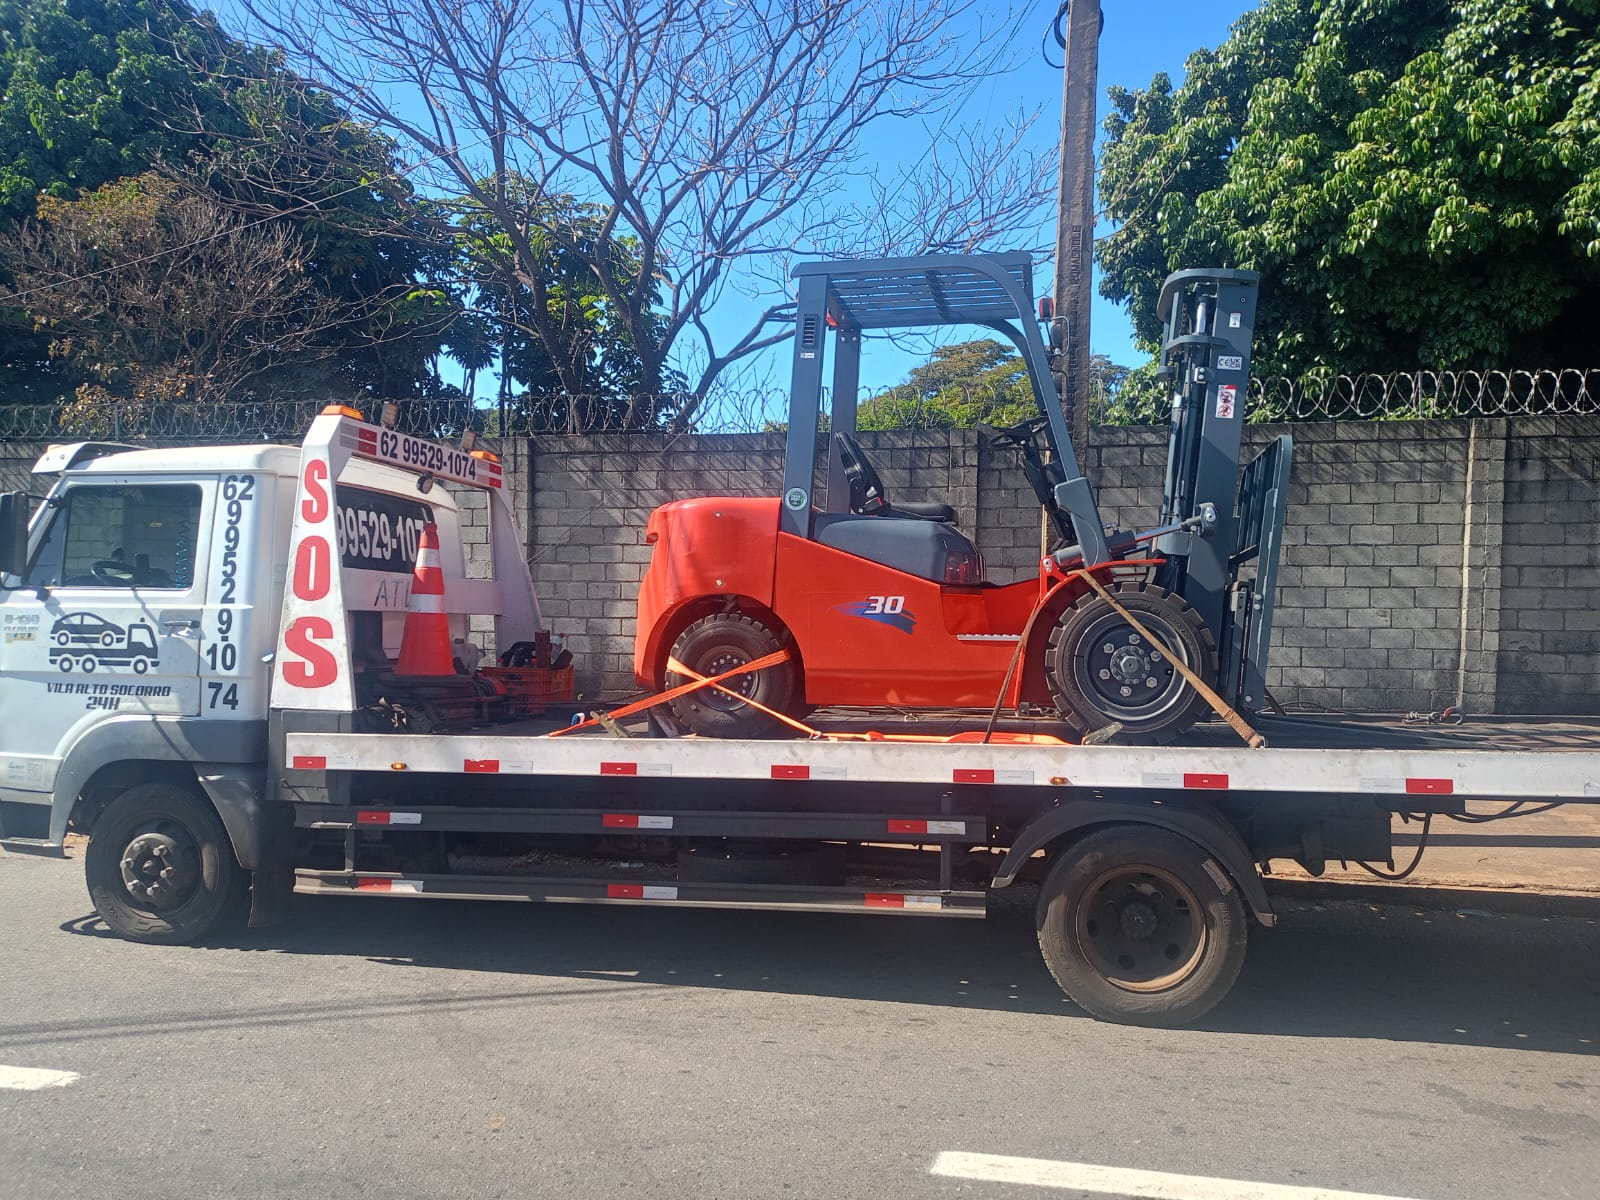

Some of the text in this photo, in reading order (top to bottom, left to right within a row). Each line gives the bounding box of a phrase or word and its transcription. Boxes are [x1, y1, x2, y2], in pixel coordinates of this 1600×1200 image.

[380, 431, 476, 481] 62 99529-1074
[223, 474, 255, 501] 62
[282, 458, 338, 689] SOS
[863, 595, 905, 615] 30
[47, 682, 172, 697] VILA ALTO SOCORRO
[86, 696, 121, 710] 24H
[208, 682, 239, 711] 74
